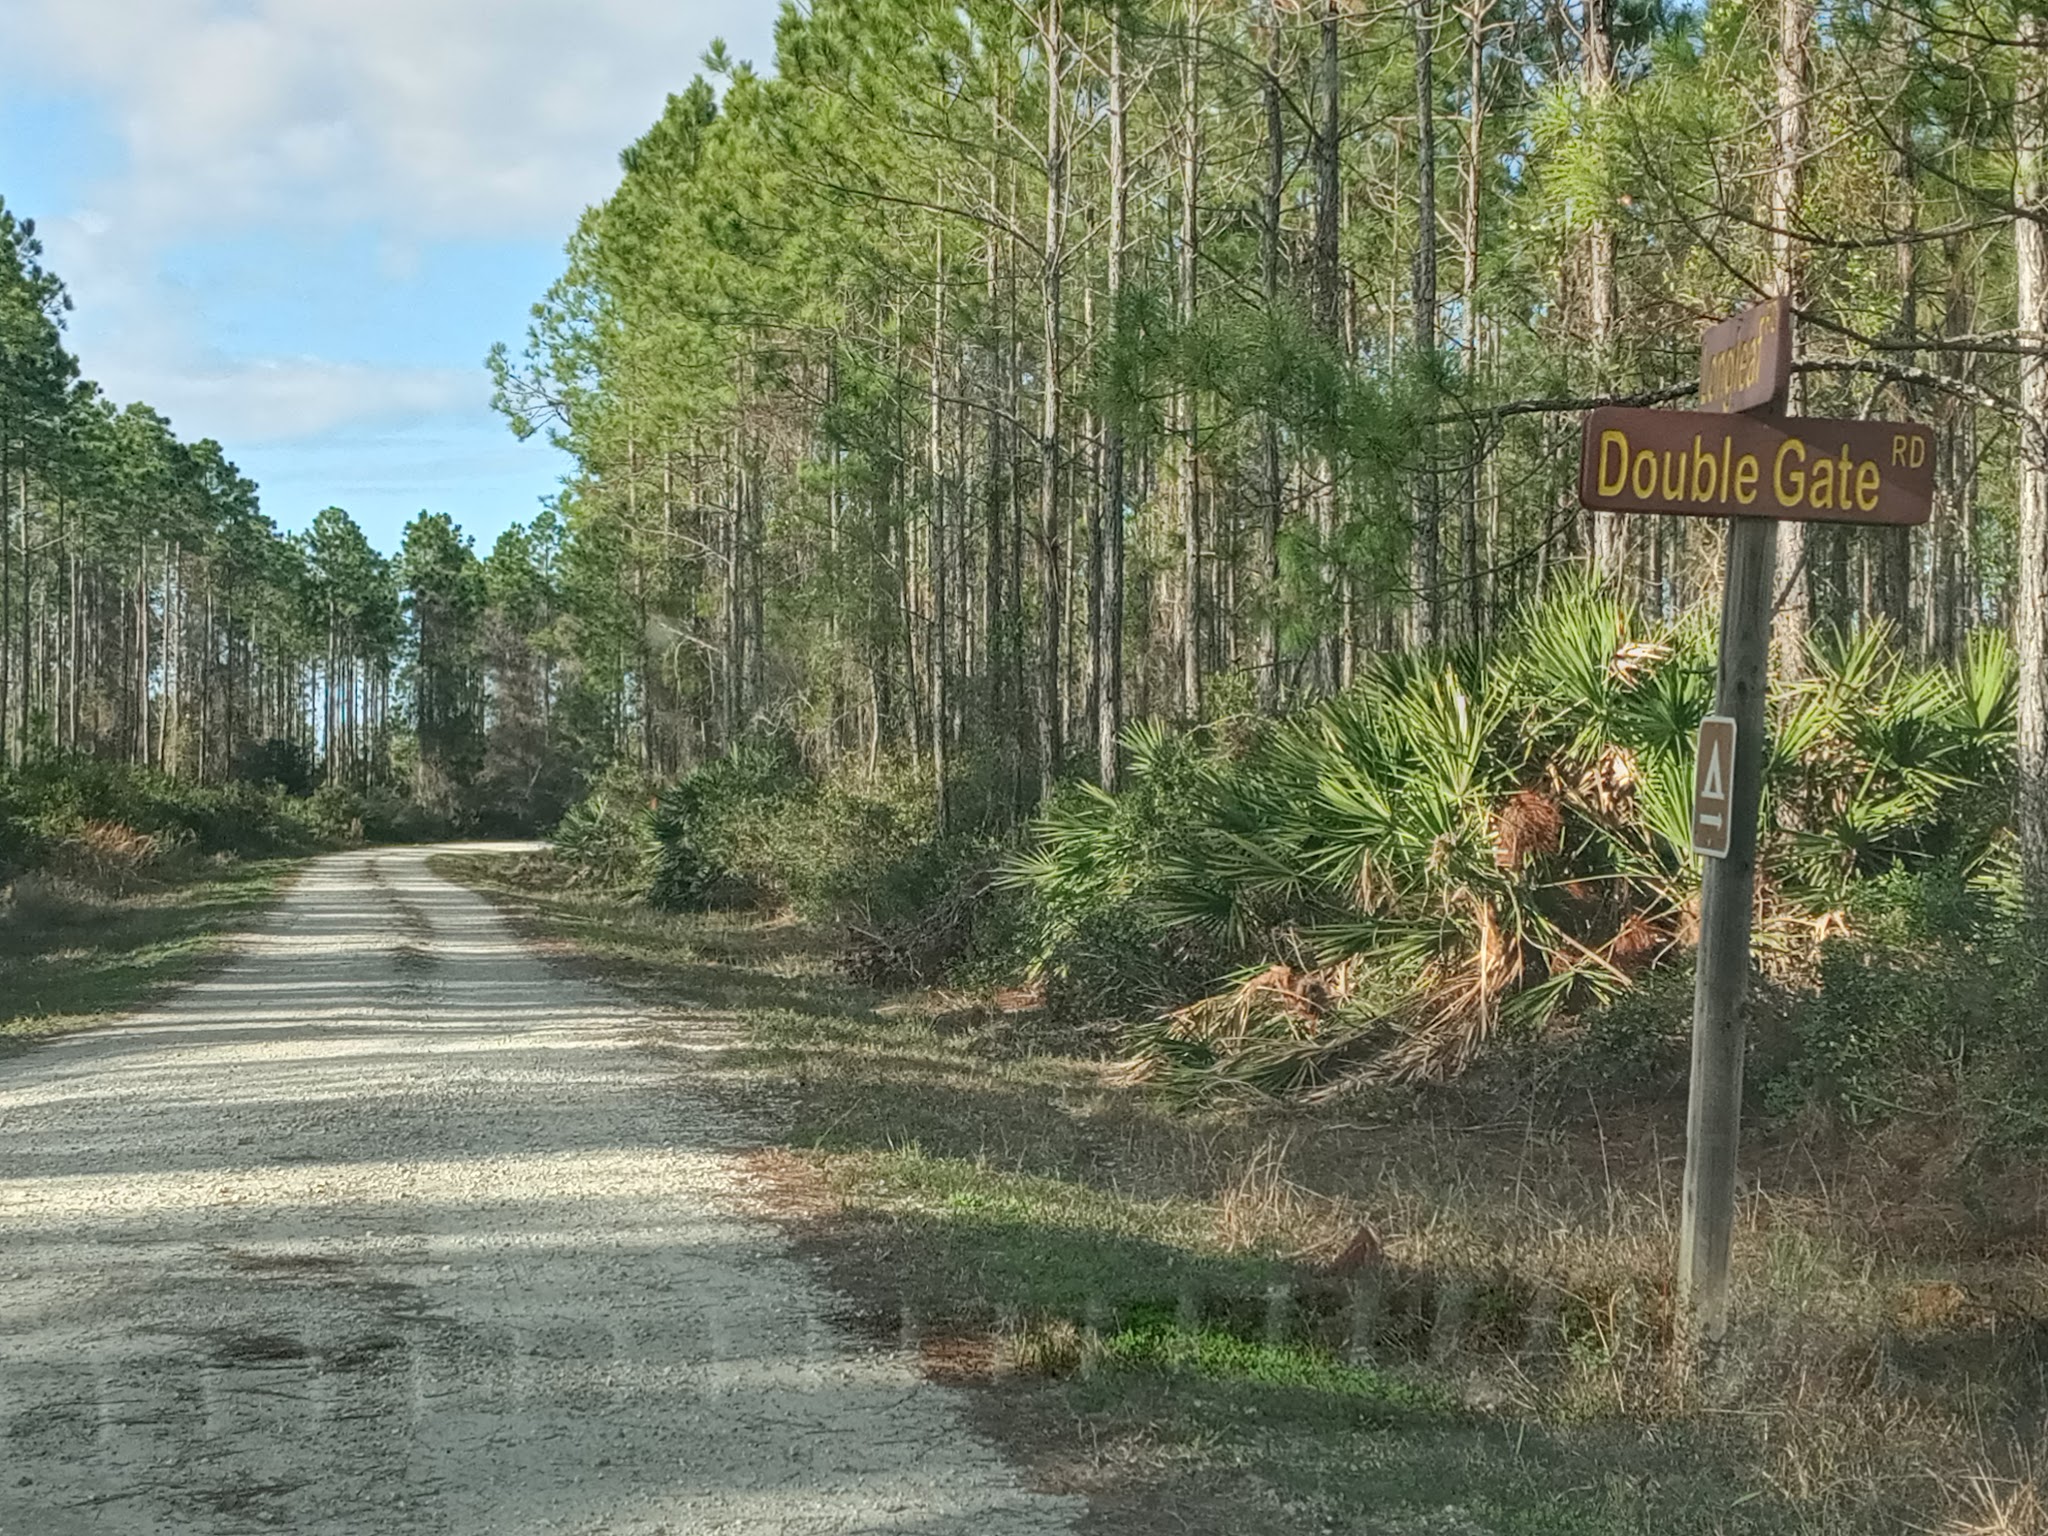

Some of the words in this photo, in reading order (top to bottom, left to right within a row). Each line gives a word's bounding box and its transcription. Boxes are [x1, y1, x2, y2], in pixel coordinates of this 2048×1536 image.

[1597, 429, 1759, 504] Double
[1774, 438, 1881, 511] Gate
[1892, 434, 1926, 469] RD
